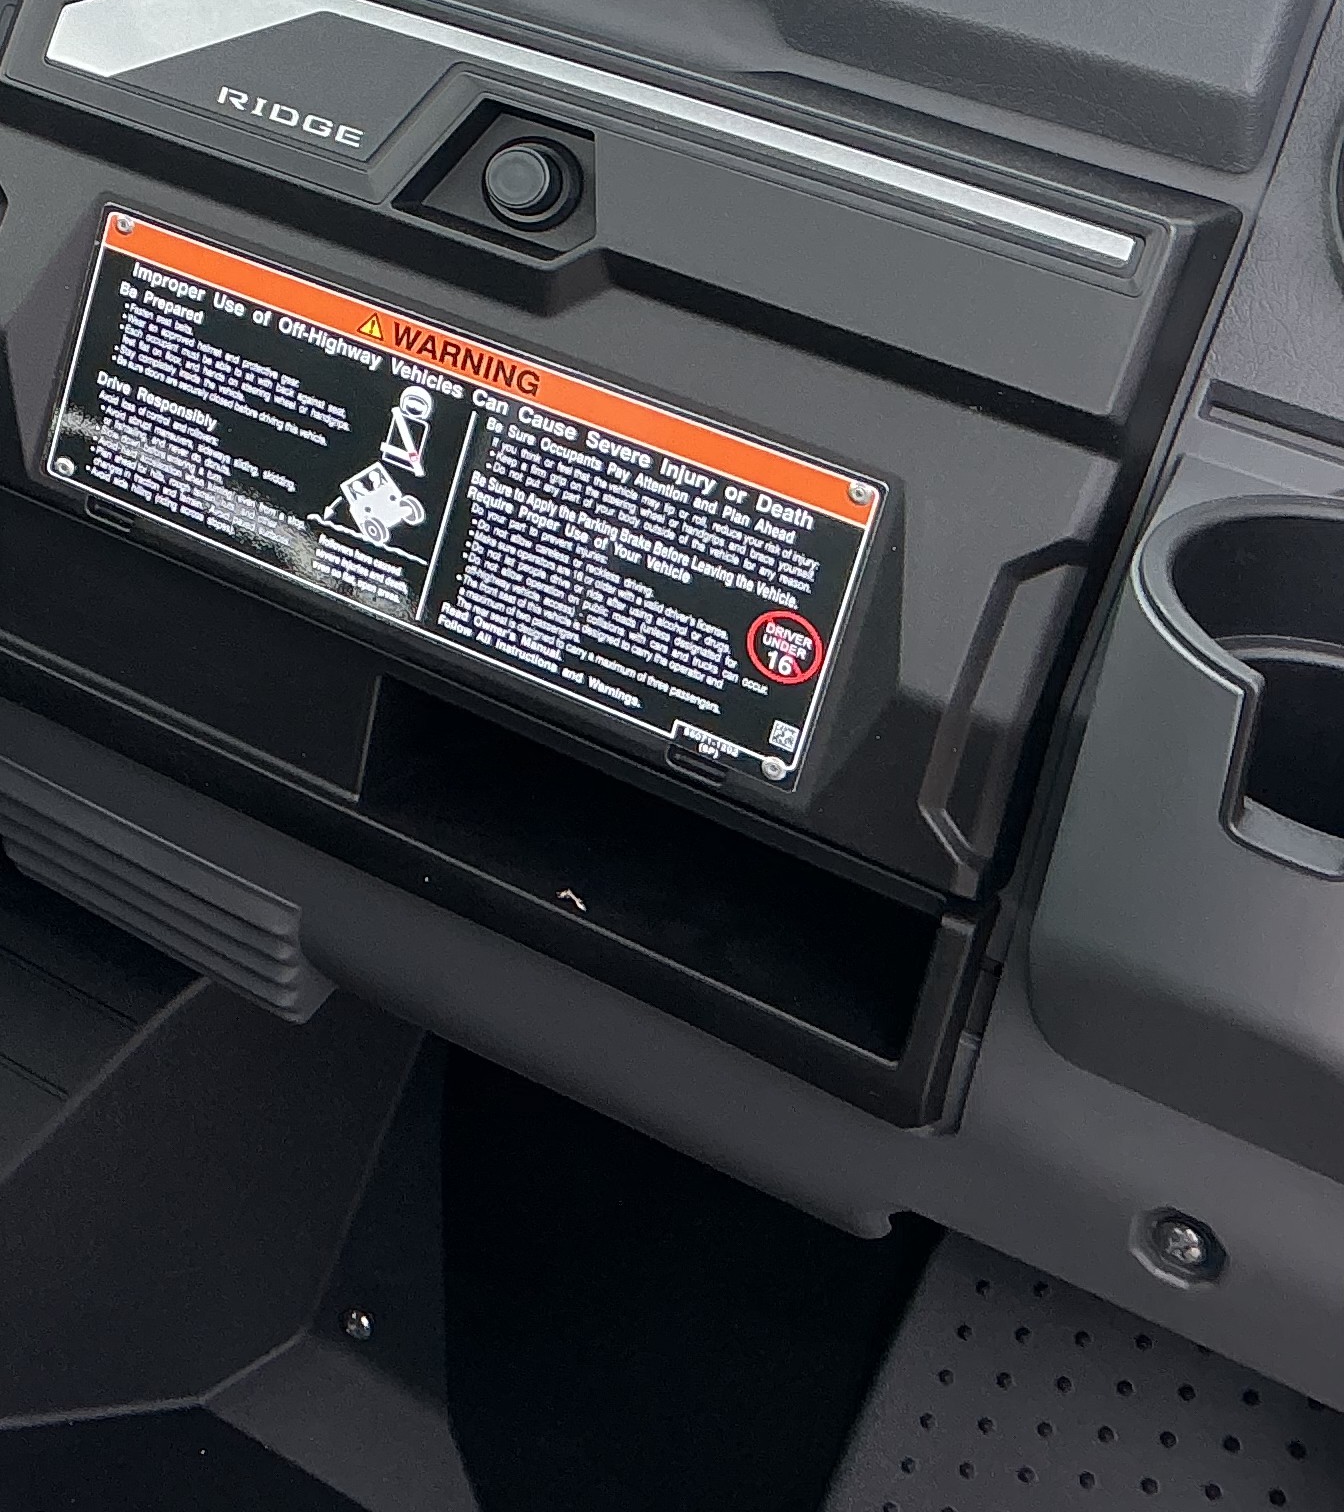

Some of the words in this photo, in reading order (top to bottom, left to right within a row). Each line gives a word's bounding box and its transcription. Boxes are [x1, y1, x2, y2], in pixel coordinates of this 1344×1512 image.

[217, 85, 365, 148] RIDGE
[120, 281, 138, 298] Be
[144, 291, 203, 324] Prepared
[394, 322, 539, 396] WARNING
[97, 371, 131, 395] Drive
[137, 387, 216, 431] Responsibly
[133, 262, 205, 300] Improper
[214, 292, 244, 316] Use
[253, 310, 272, 326] of
[279, 317, 381, 370] Off-Highway
[392, 358, 463, 398] Vehicles
[473, 389, 509, 415] Can
[519, 406, 577, 440] Cause
[586, 431, 650, 468] Severe
[660, 458, 716, 494] Injury
[725, 486, 747, 504] or
[756, 494, 816, 529] Death
[486, 417, 504, 433] Be
[508, 425, 536, 445] Sure
[541, 438, 602, 471] Occupants
[607, 462, 630, 483] Pay
[634, 473, 688, 503] Attention
[693, 497, 718, 514] and
[722, 505, 750, 527] Plan
[754, 519, 795, 544] Ahead
[467, 486, 514, 514] Require
[518, 506, 560, 531] Proper
[565, 523, 589, 543] Use
[594, 537, 609, 550] of
[611, 539, 642, 563] Your
[647, 555, 690, 583] Vehicle
[471, 470, 486, 487] Be
[488, 477, 512, 497] Sure
[513, 488, 525, 502] to
[524, 493, 558, 517] Apply
[559, 505, 576, 522] the
[577, 512, 618, 541] Parking
[619, 528, 652, 551] Brake
[653, 541, 690, 566] Before
[691, 556, 734, 586] Leaving
[736, 574, 754, 592] the
[757, 581, 797, 609] Vehicle.
[438, 614, 472, 636] Follow
[476, 631, 492, 645] All
[562, 668, 584, 683] and
[589, 676, 640, 707] Warnings.
[762, 633, 807, 661] UNDER
[765, 621, 813, 650] DRIVER
[767, 650, 793, 676] 16
